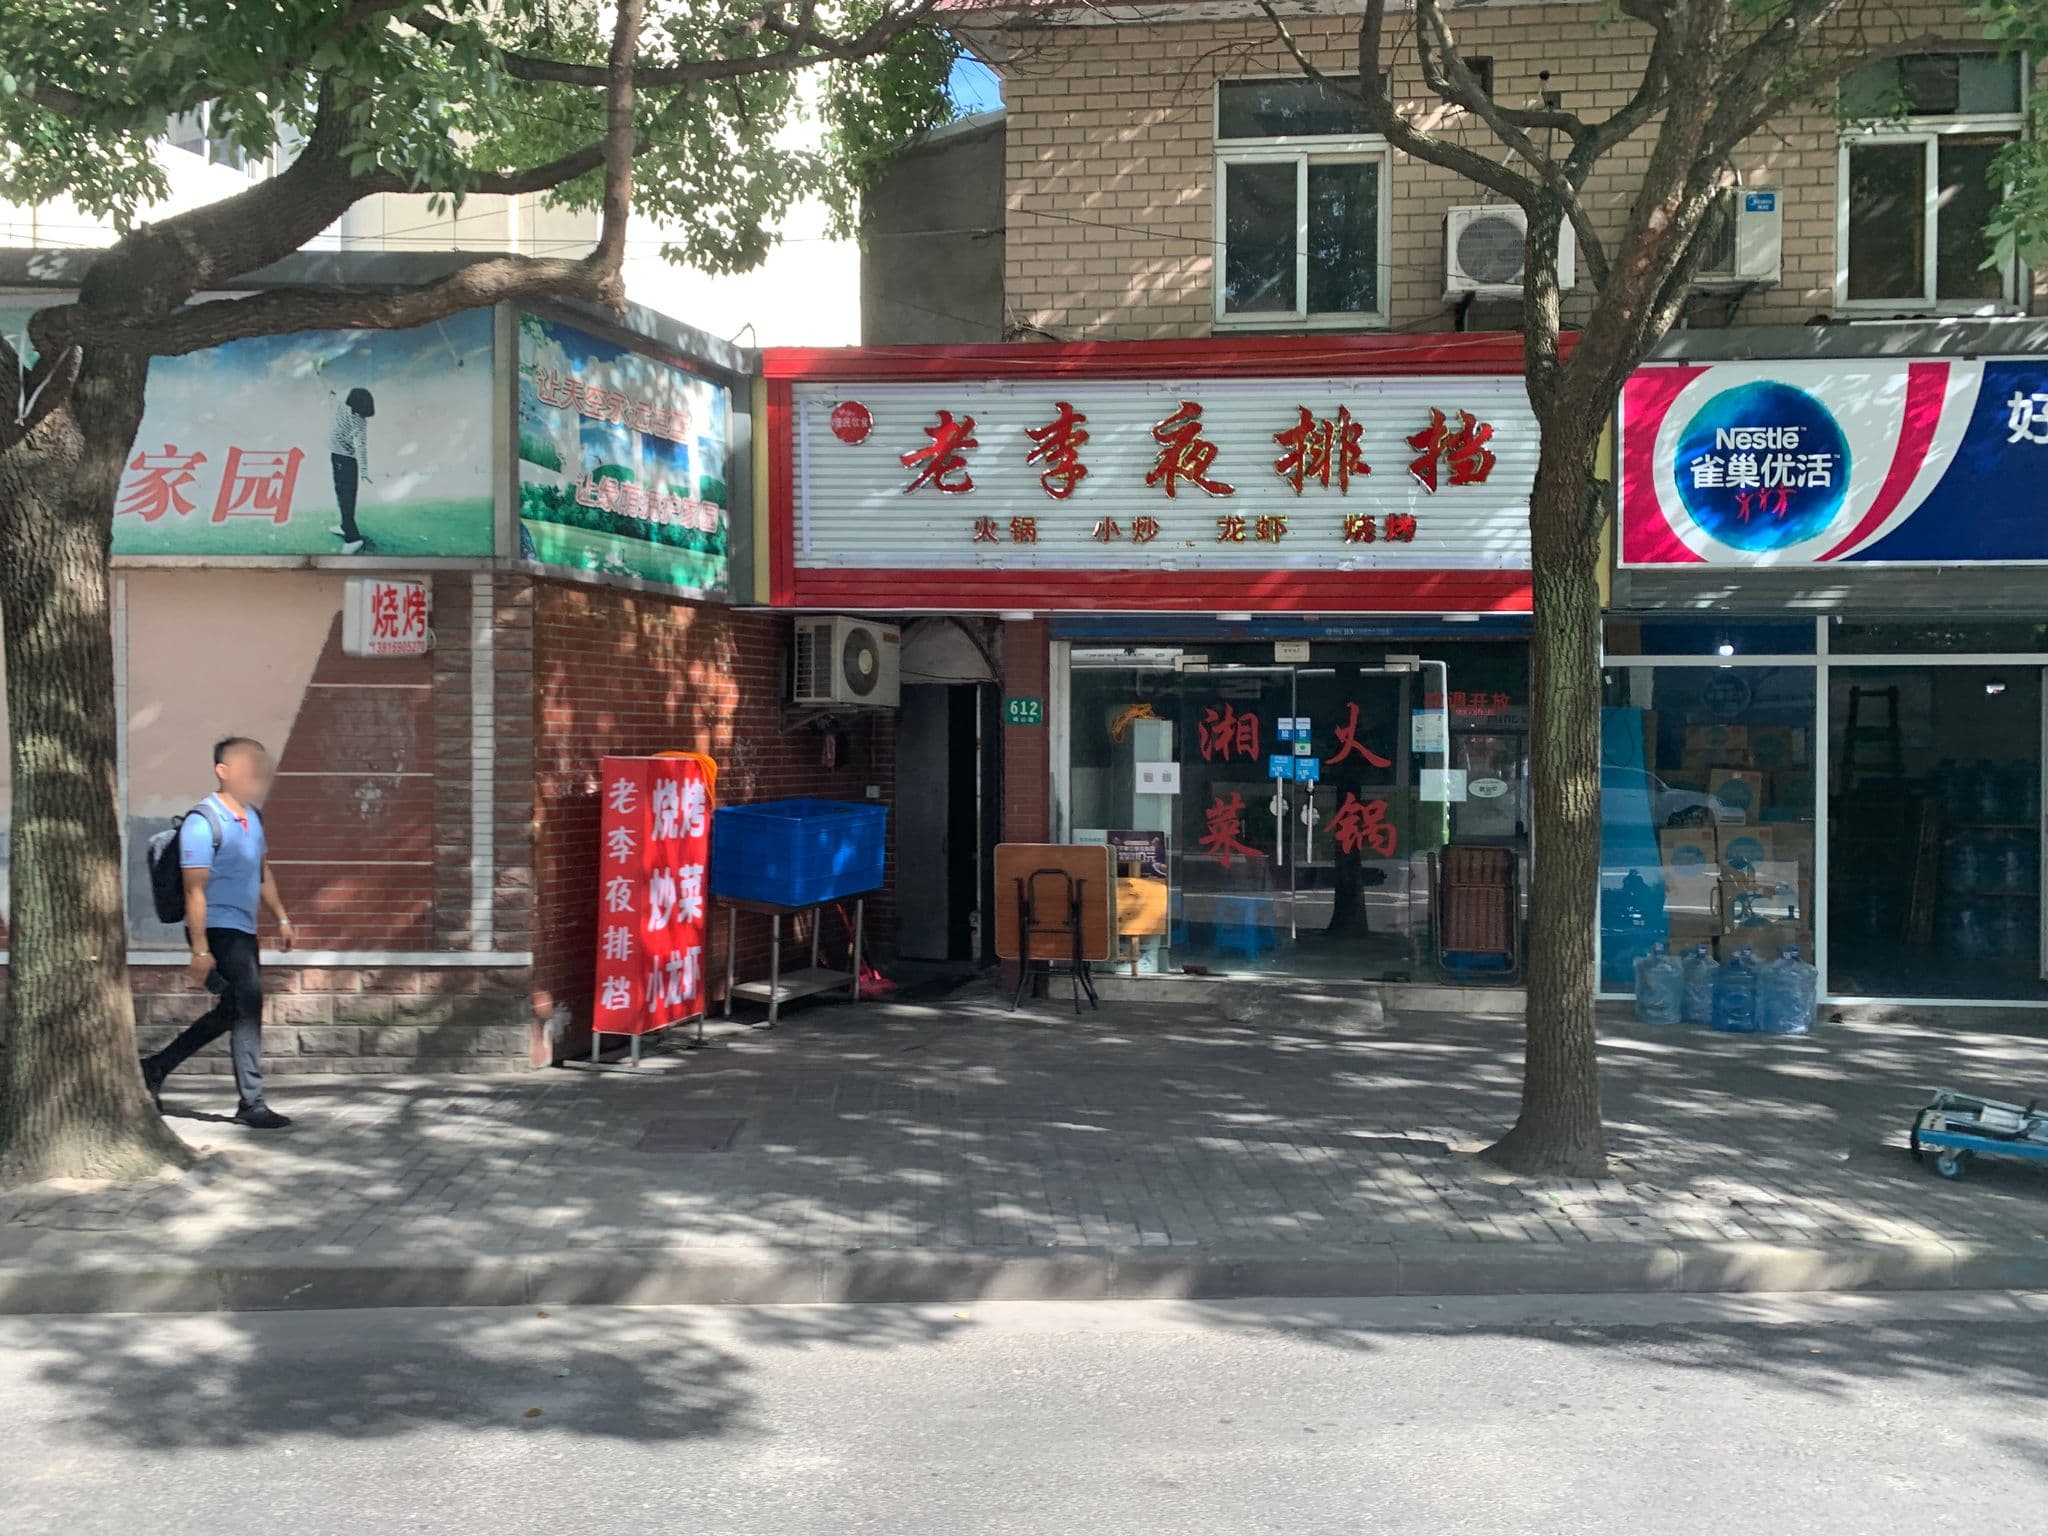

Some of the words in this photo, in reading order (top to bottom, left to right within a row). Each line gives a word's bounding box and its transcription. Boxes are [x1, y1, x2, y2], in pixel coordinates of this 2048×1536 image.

[1716, 426, 1800, 451] Nestlé
[2007, 391, 2048, 444] 好
[116, 444, 305, 524] 家园
[1690, 453, 1833, 489] 雀巢优活
[973, 515, 1037, 544] 火锅
[1092, 515, 1160, 544] 小炒
[1217, 514, 1288, 544] 龙虾
[1344, 513, 1417, 544] 烧烤
[371, 583, 427, 638] 烧烤
[1010, 701, 1038, 716] 612
[651, 777, 705, 841] 烧烤
[1198, 703, 1264, 868] 湘菜
[1323, 702, 1397, 857] 火锅
[647, 864, 705, 932] 炒菜
[645, 945, 703, 1013] 小龙虾
